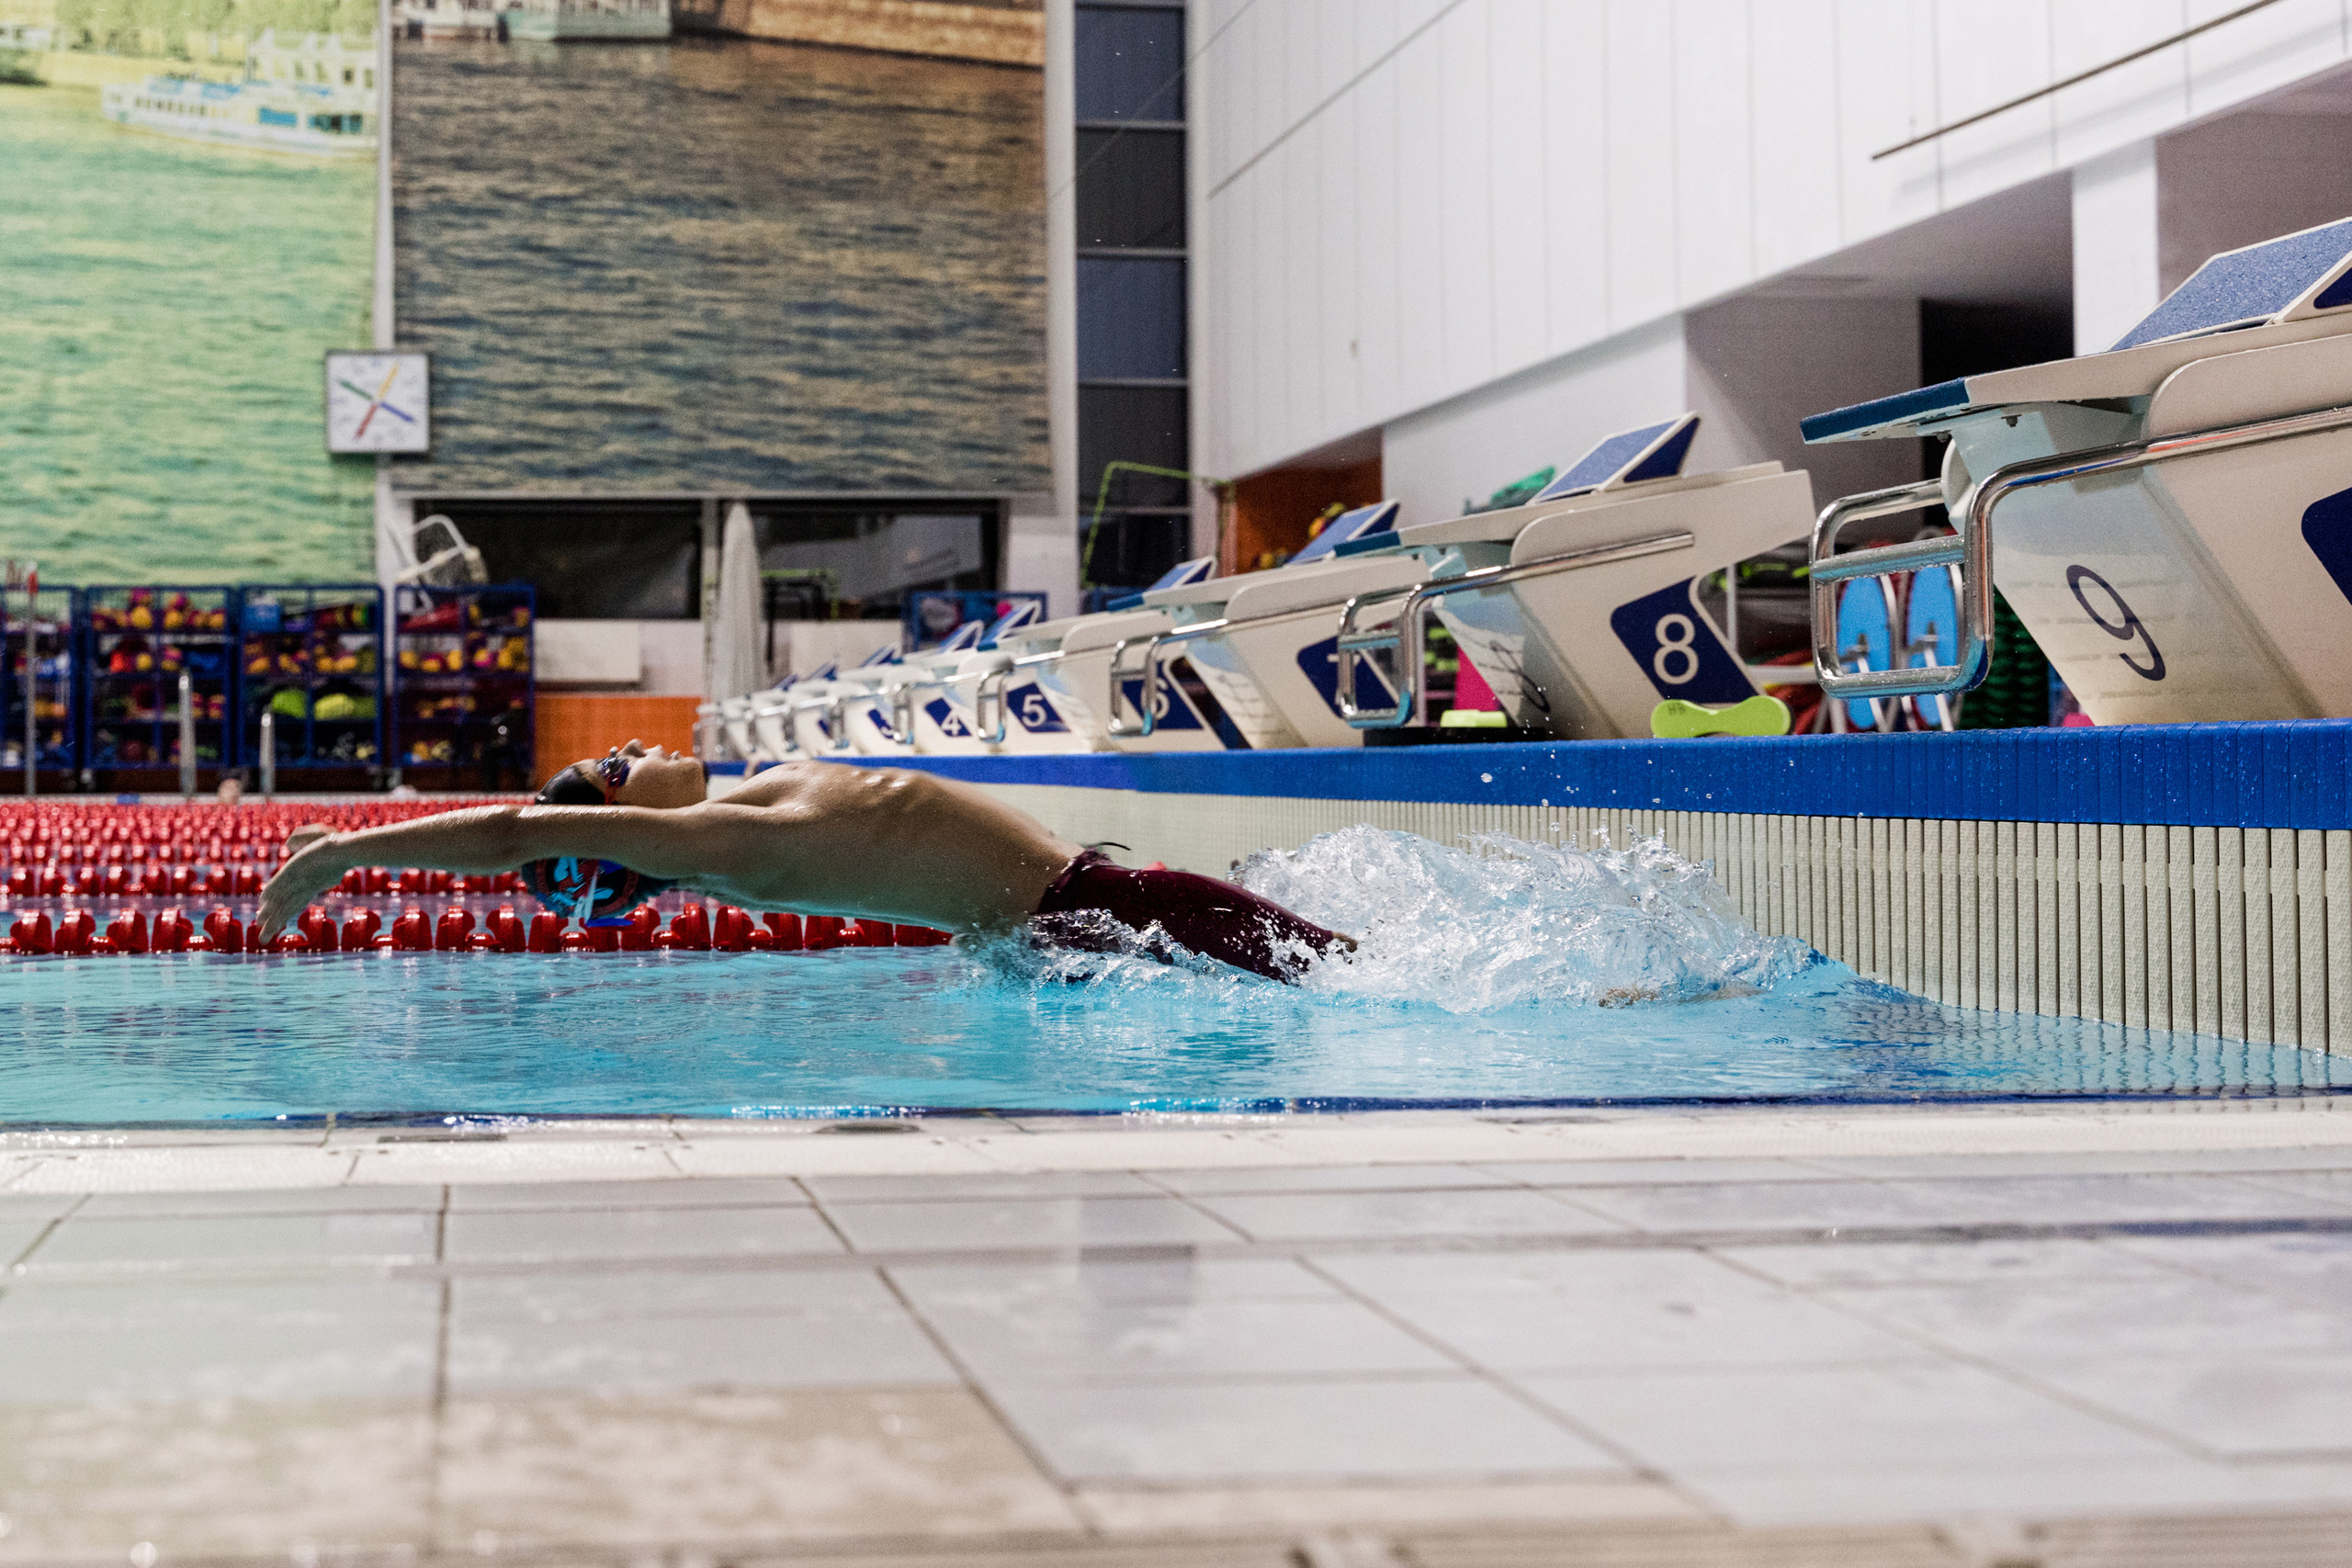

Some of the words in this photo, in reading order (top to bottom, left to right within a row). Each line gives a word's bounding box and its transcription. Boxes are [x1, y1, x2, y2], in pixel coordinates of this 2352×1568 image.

[2066, 565, 2165, 681] 9
[1654, 613, 1698, 684] 8
[1022, 694, 1046, 727] 5
[1141, 676, 1170, 720] 6
[940, 705, 963, 736] 4
